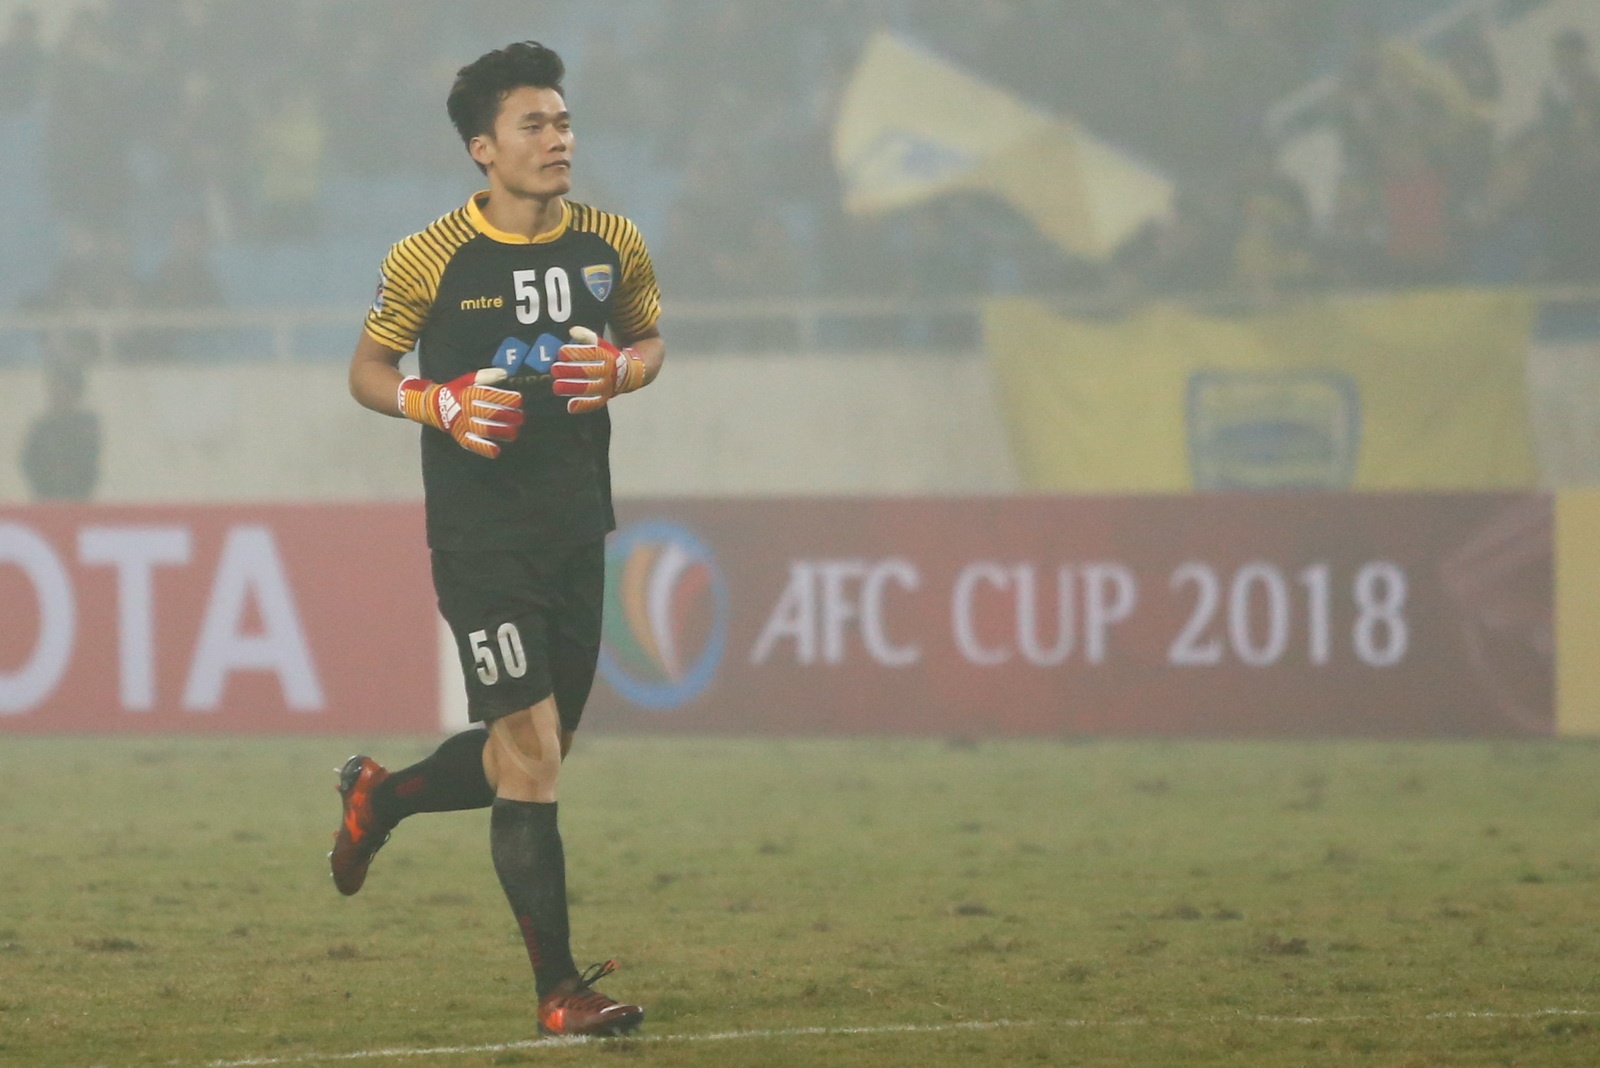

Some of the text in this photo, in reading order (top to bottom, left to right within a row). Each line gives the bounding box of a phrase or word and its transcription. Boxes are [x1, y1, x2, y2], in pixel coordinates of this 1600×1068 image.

[460, 296, 503, 310] mitre
[512, 266, 572, 325] 50
[438, 387, 450, 429] adidas
[751, 560, 1409, 667] AFC CUP 2018
[468, 622, 527, 686] 50
